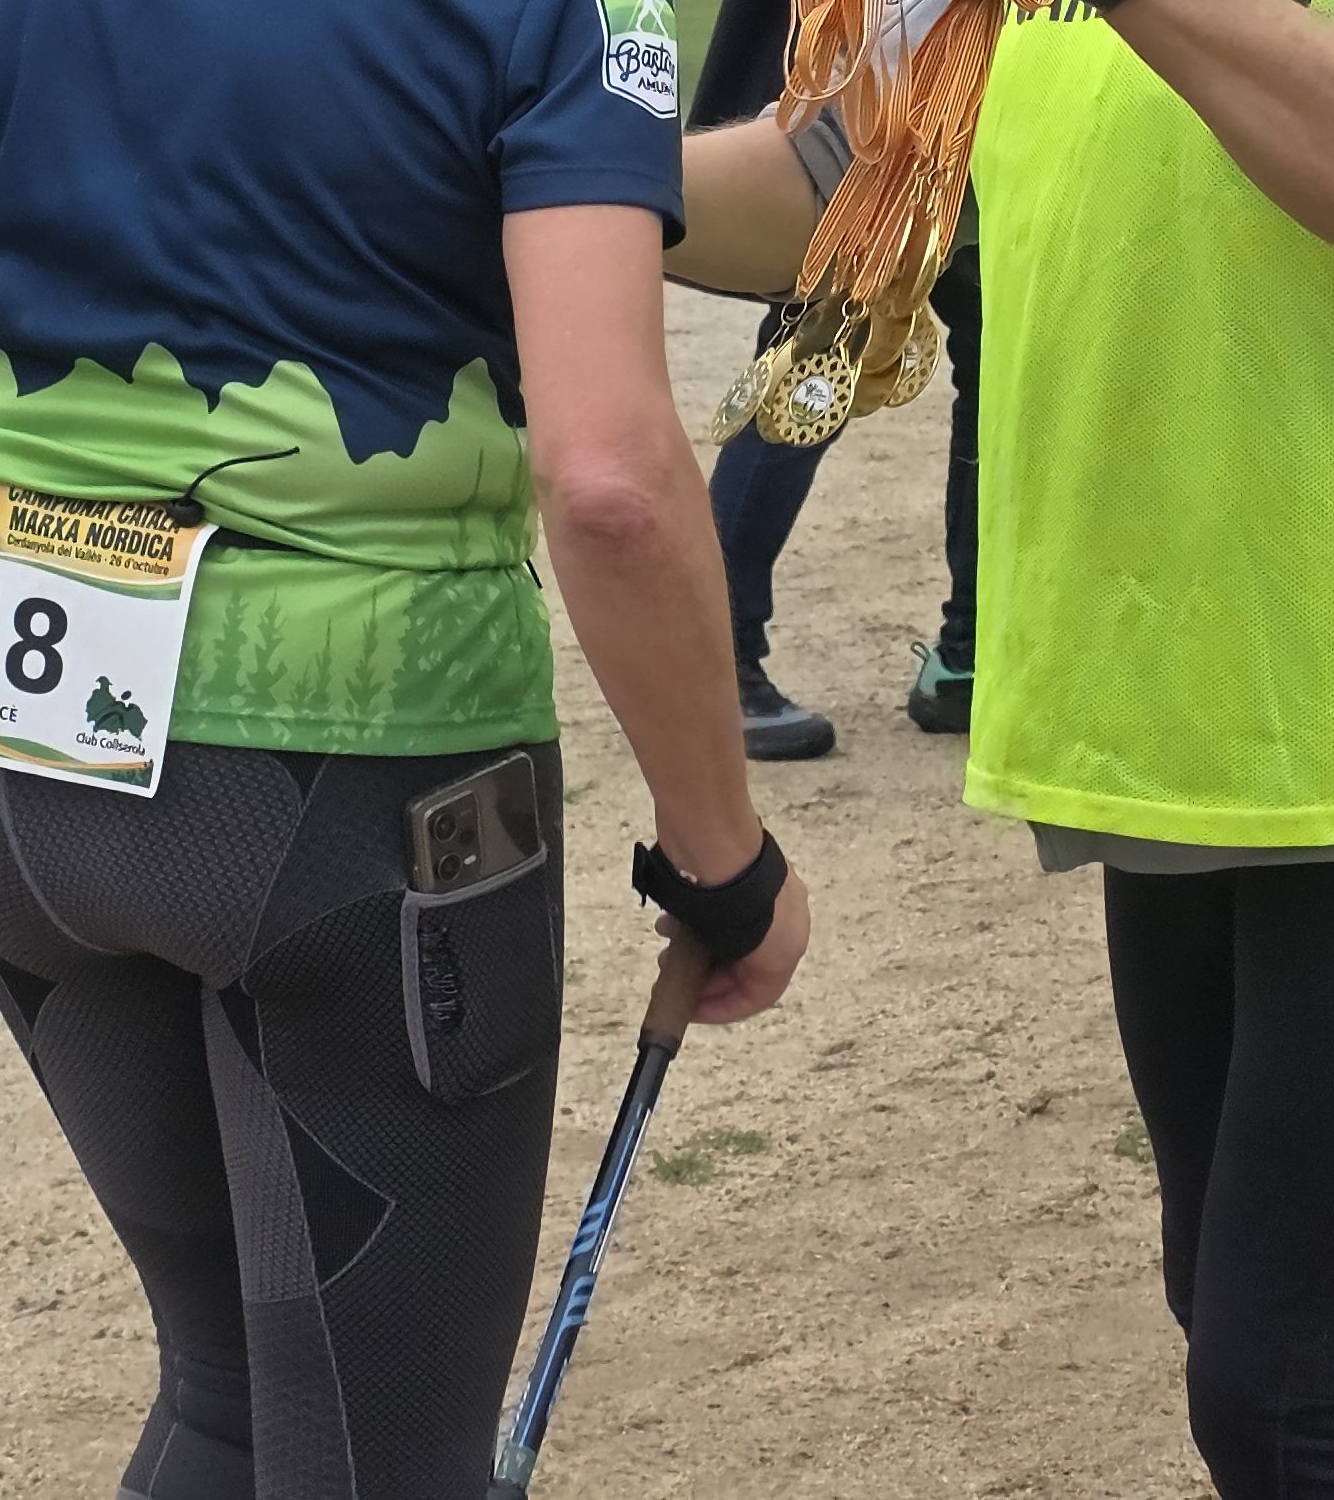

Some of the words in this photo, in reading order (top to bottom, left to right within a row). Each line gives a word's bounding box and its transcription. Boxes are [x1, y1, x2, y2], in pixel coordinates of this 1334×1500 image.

[9, 506, 80, 543] MARXA
[84, 520, 174, 562] NÒRDICA
[57, 543, 71, 558] del
[109, 553, 122, 568] 26
[76, 732, 97, 747] Club
